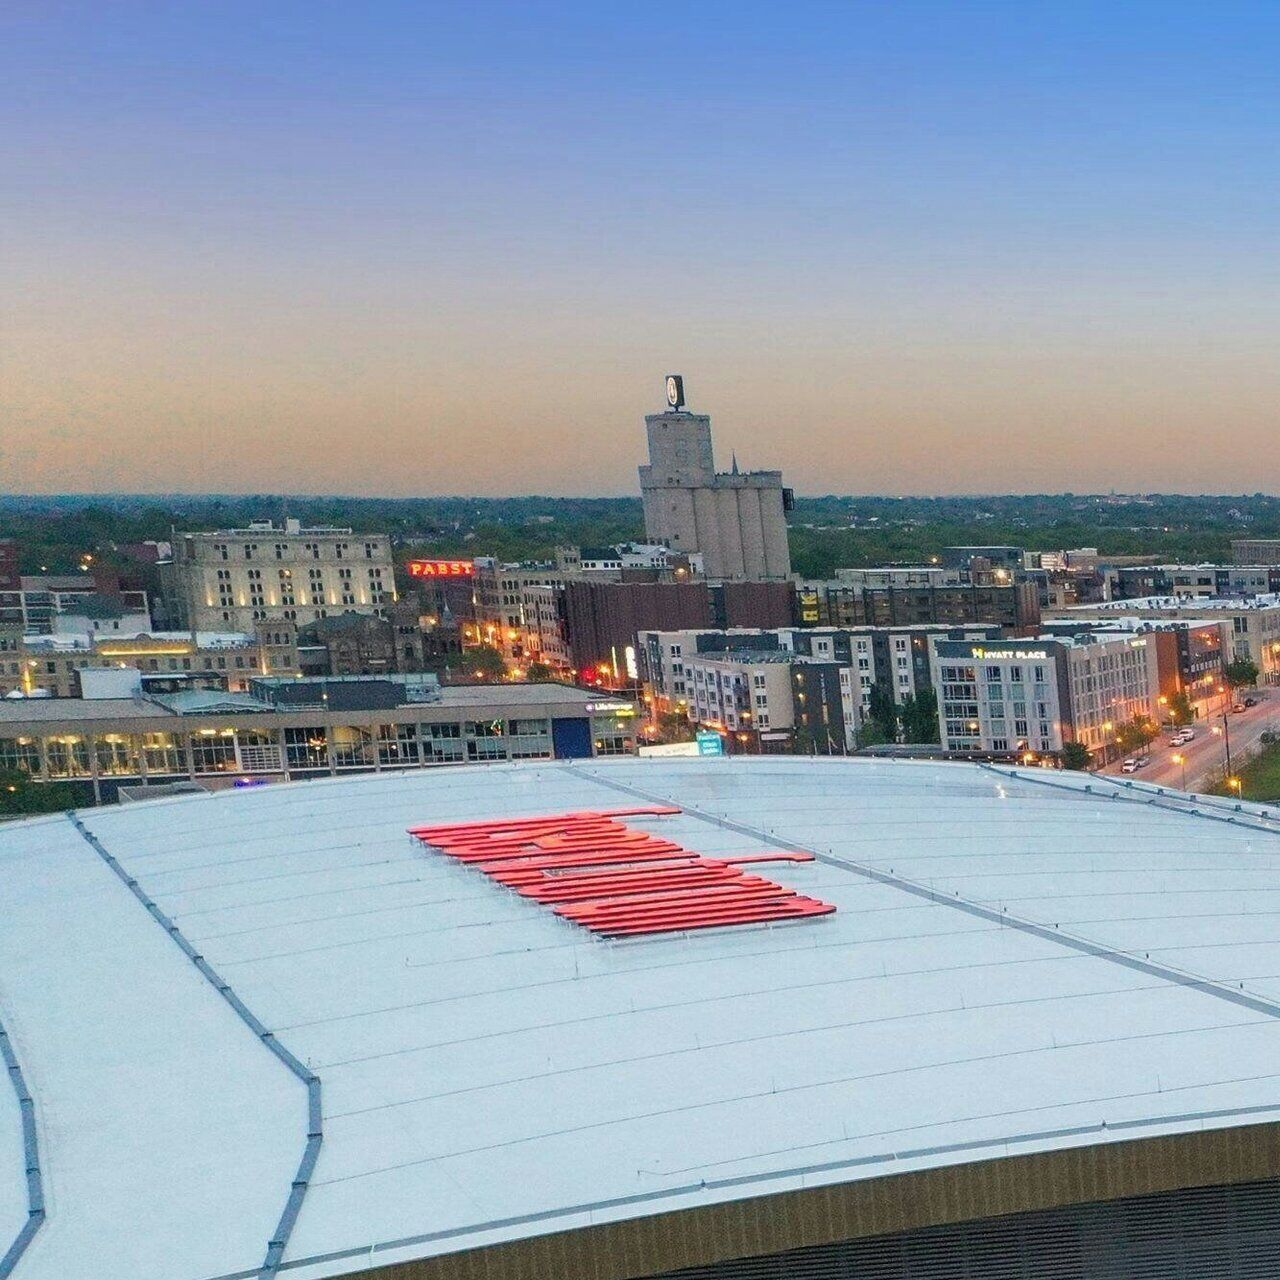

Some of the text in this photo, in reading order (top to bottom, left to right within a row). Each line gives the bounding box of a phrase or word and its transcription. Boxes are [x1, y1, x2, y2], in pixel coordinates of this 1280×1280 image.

[410, 562, 473, 576] PABST
[984, 650, 1047, 659] HYATT PLACE
